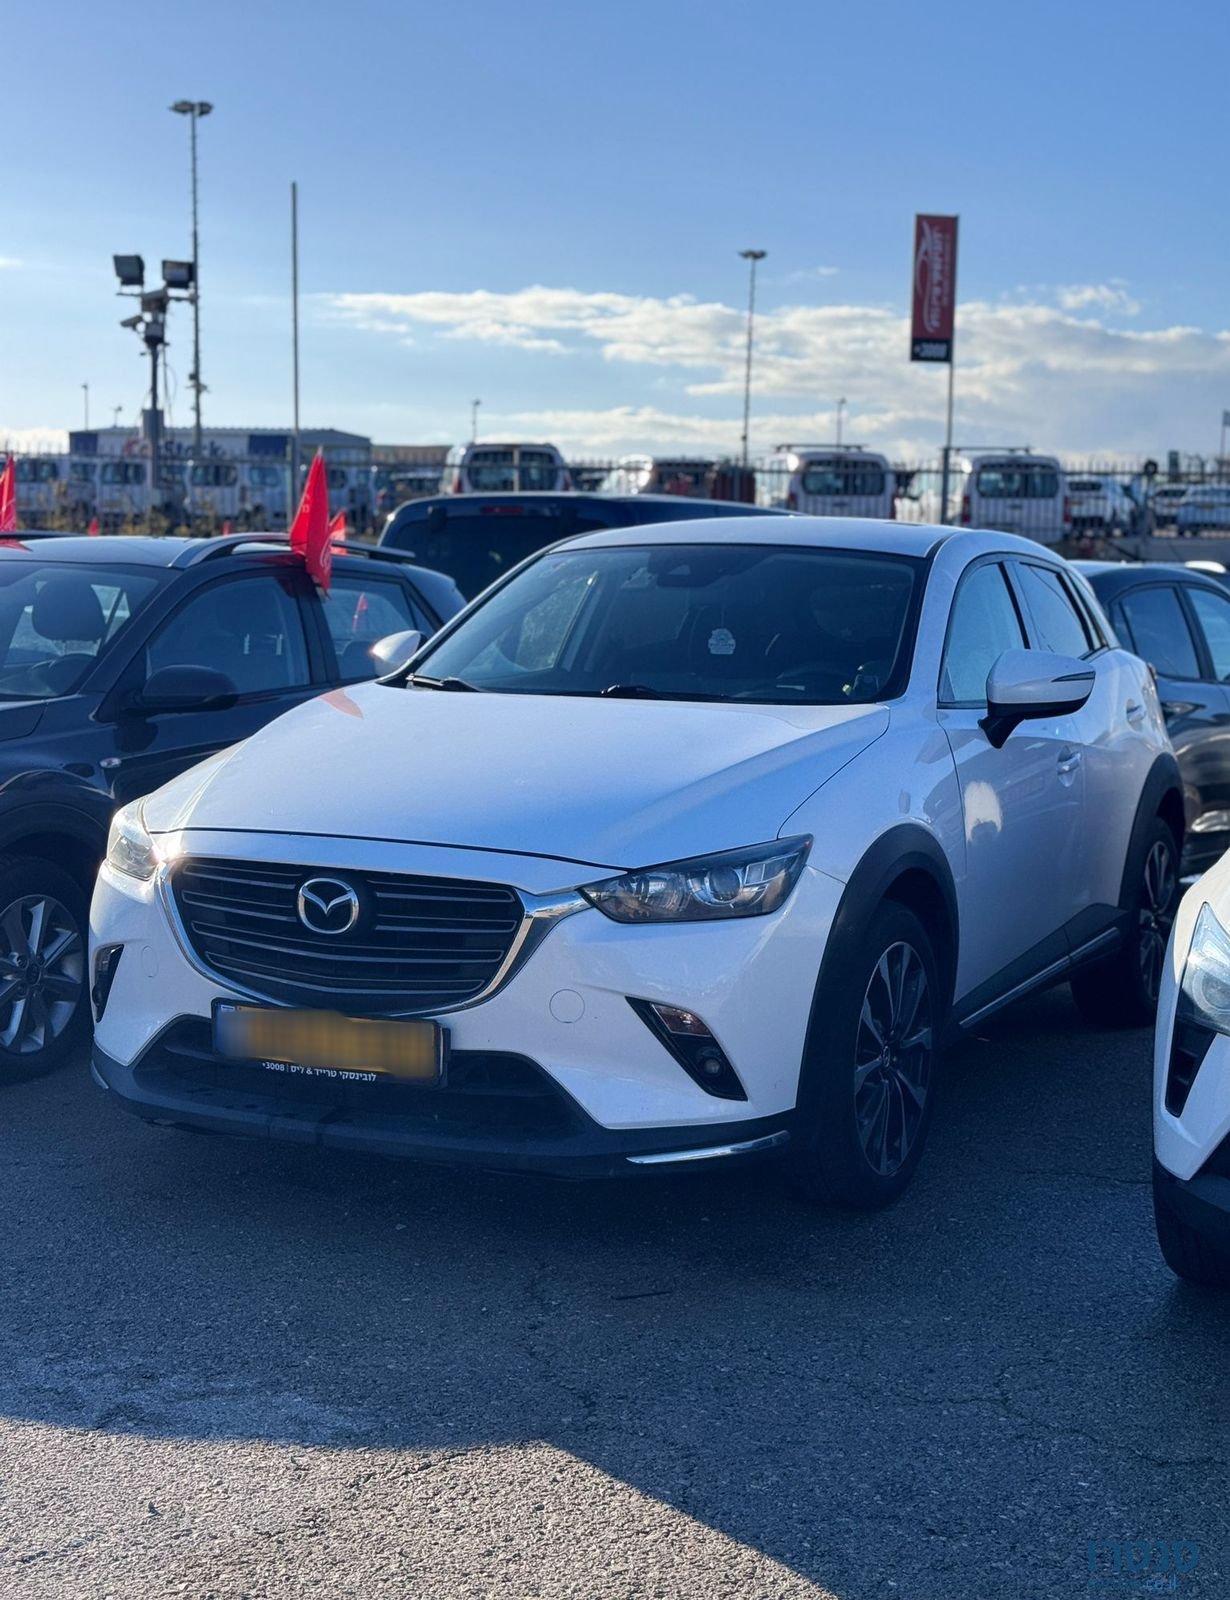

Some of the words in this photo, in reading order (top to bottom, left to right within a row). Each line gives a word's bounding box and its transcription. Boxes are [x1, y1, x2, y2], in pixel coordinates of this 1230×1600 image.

[290, 1065, 304, 1074] ליס
[306, 1067, 313, 1076] &
[314, 1068, 337, 1078] טרייד
[339, 1071, 377, 1082] לובינסקי
